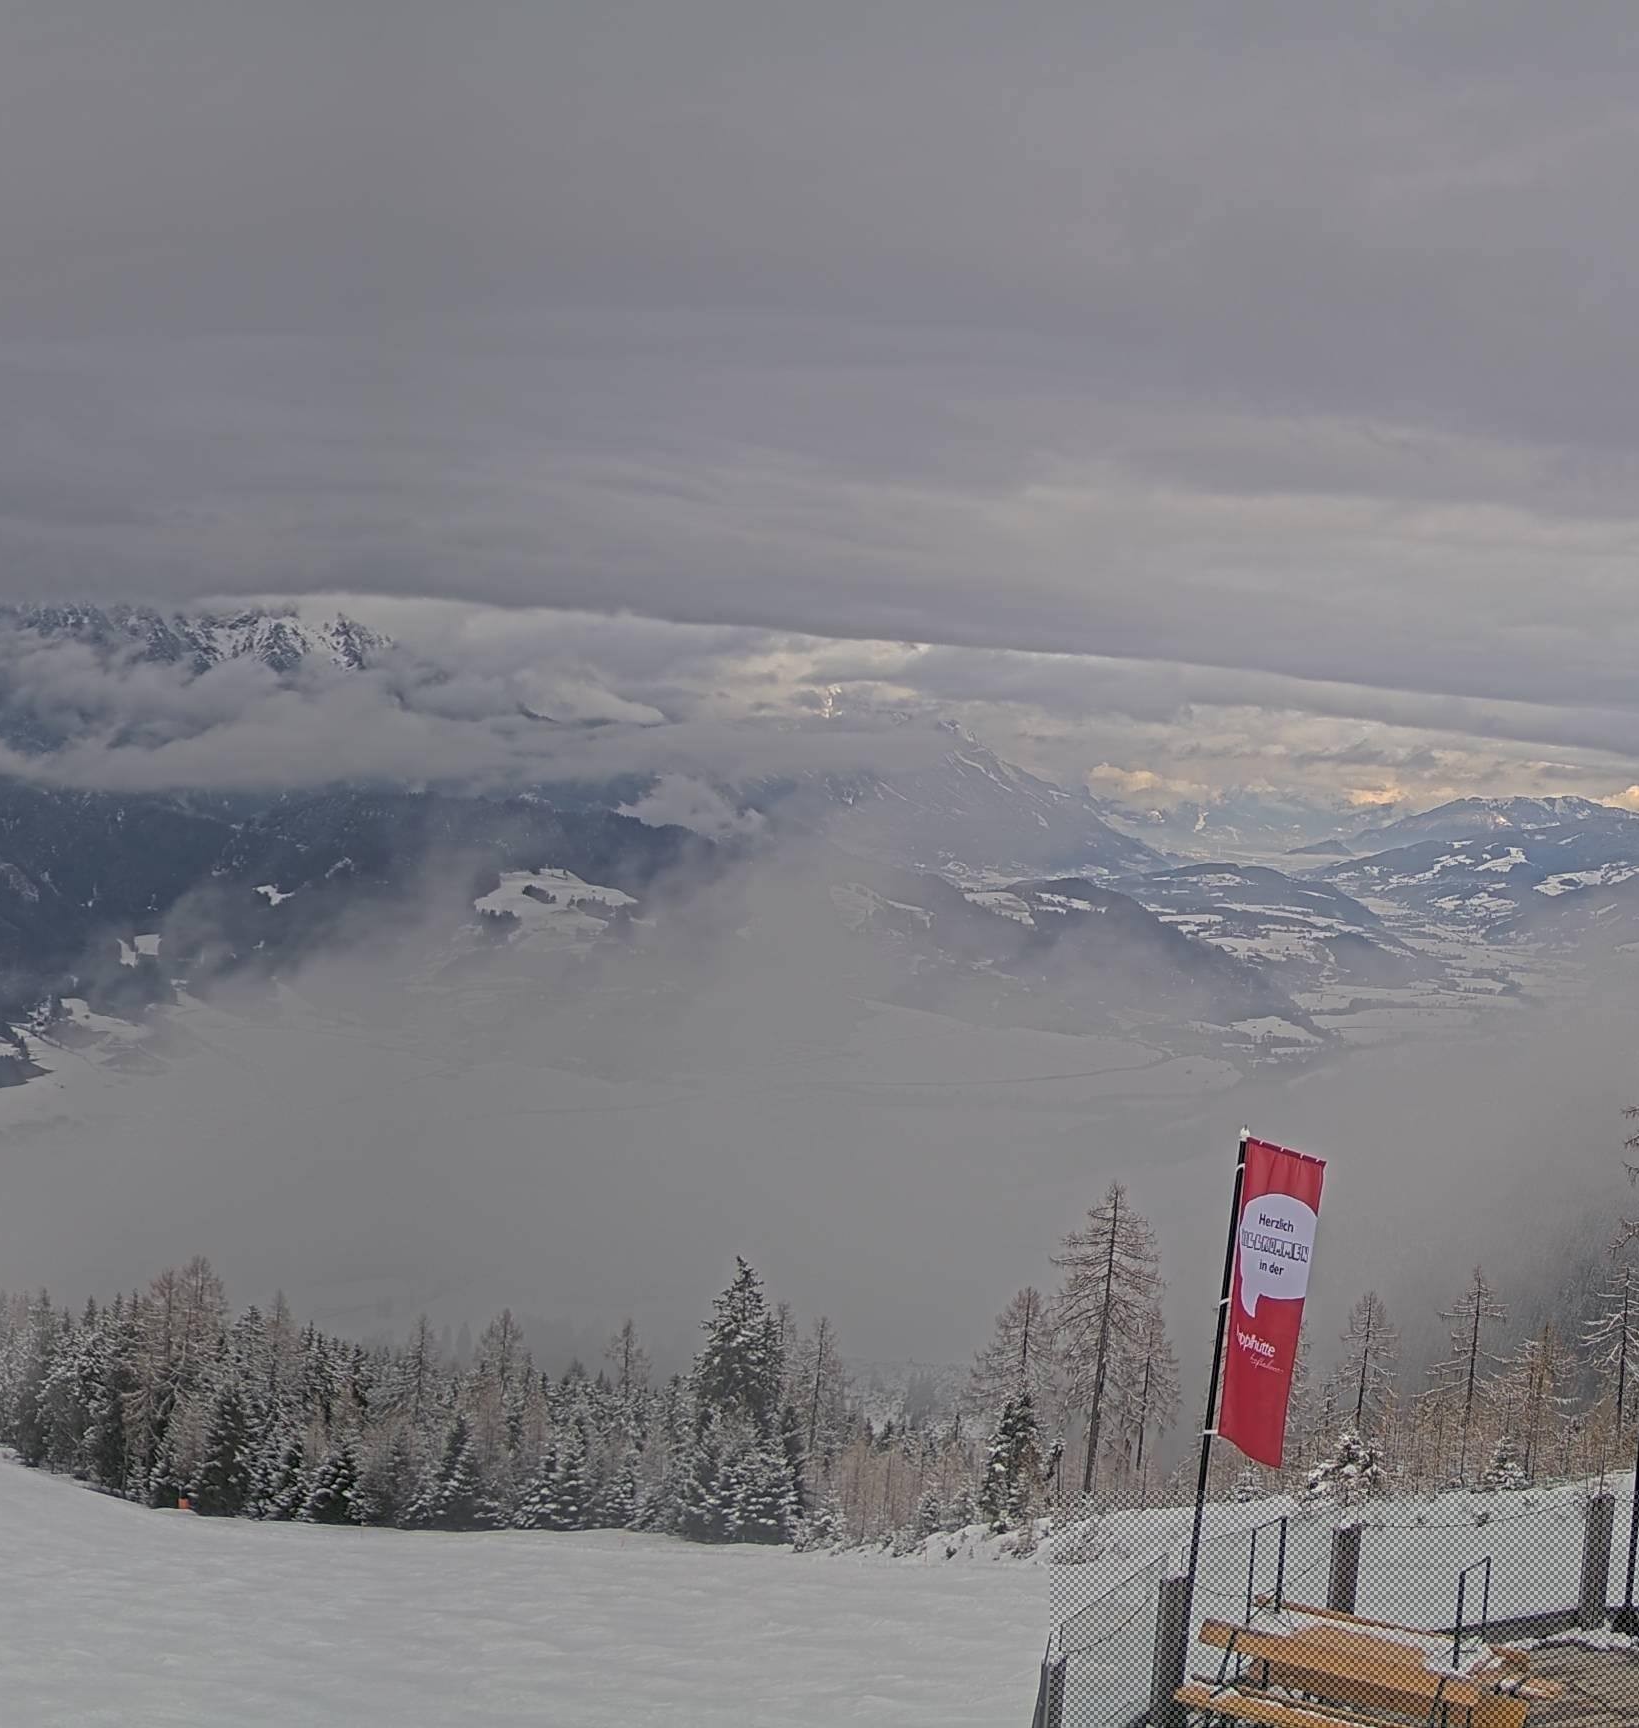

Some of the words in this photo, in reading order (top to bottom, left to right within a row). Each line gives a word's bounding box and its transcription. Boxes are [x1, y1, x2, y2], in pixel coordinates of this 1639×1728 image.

[1258, 1213, 1294, 1233] Herzlich
[1242, 1229, 1310, 1263] ILLKOMMEN
[1259, 1259, 1268, 1272] in
[1269, 1262, 1284, 1275] der
